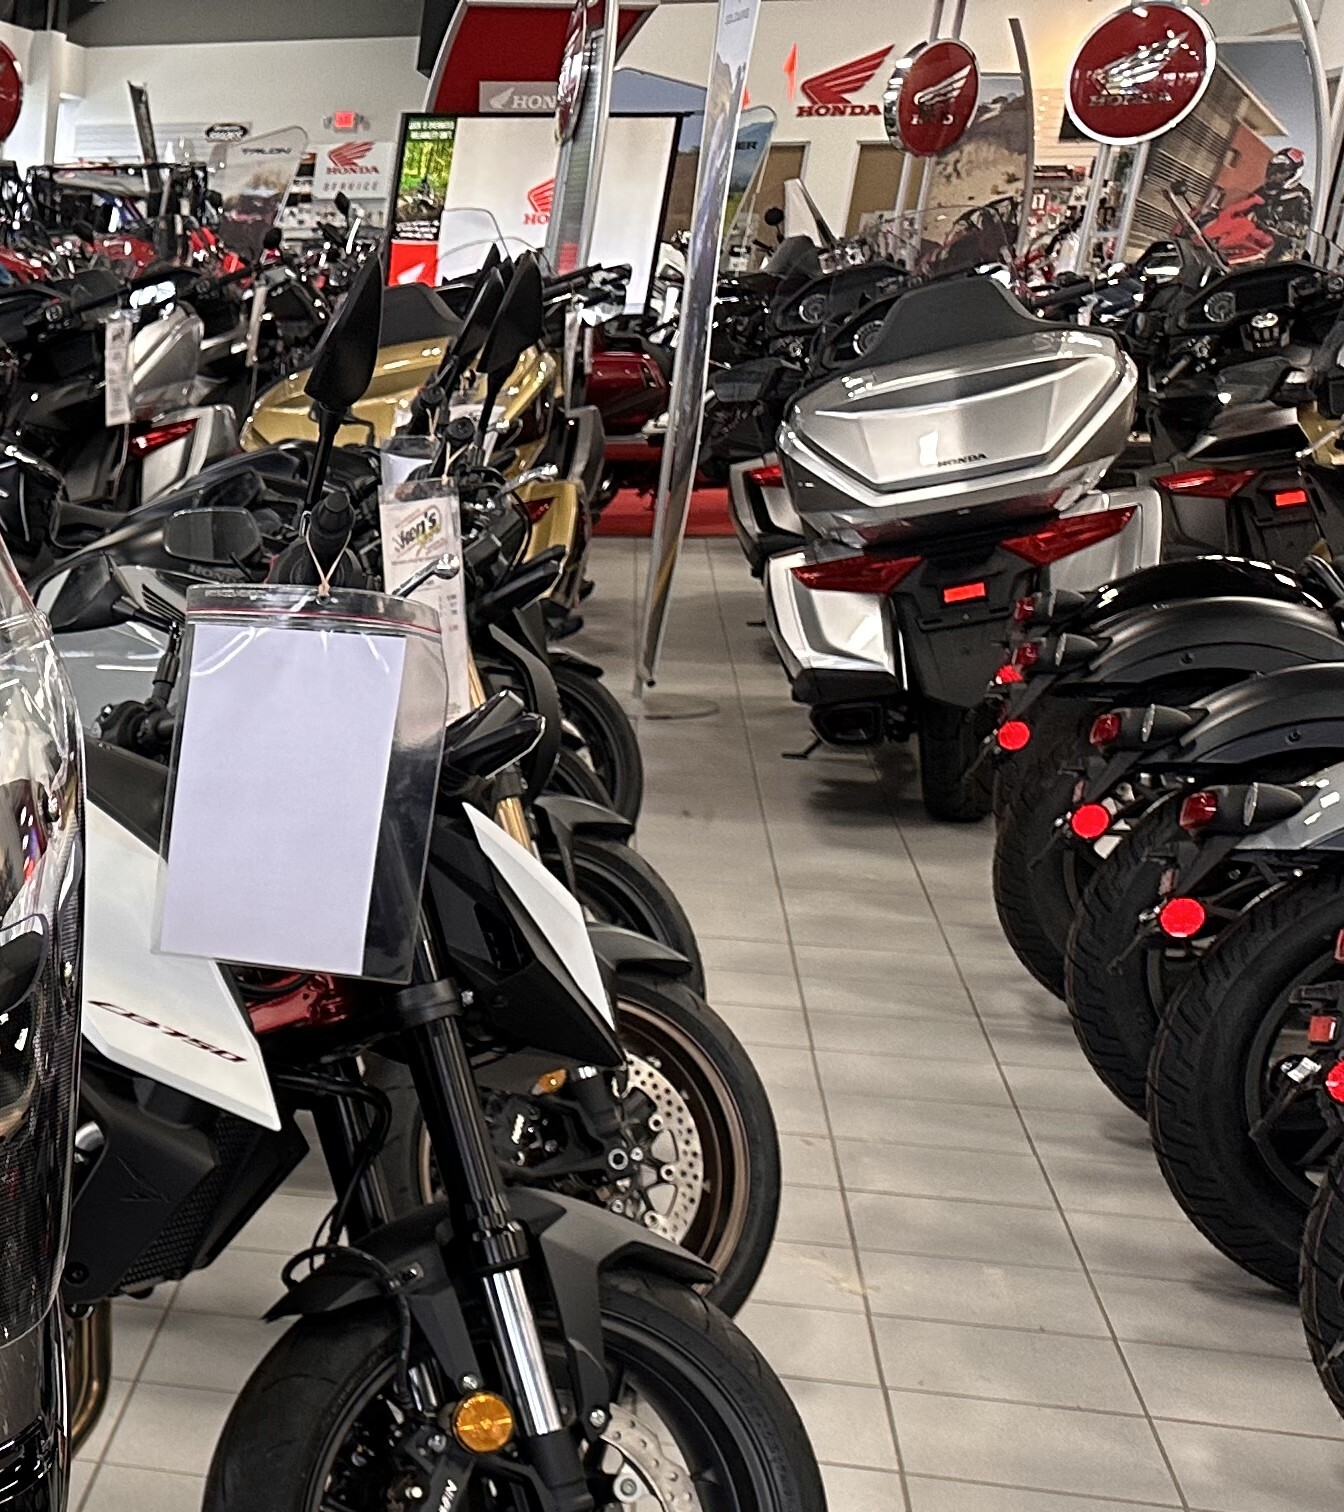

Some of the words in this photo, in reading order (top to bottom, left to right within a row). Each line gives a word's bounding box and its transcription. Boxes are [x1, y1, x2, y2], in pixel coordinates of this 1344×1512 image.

[511, 95, 558, 110] HON
[796, 104, 883, 118] HONDA
[326, 164, 380, 175] HONDA
[322, 180, 379, 192] SERVICE
